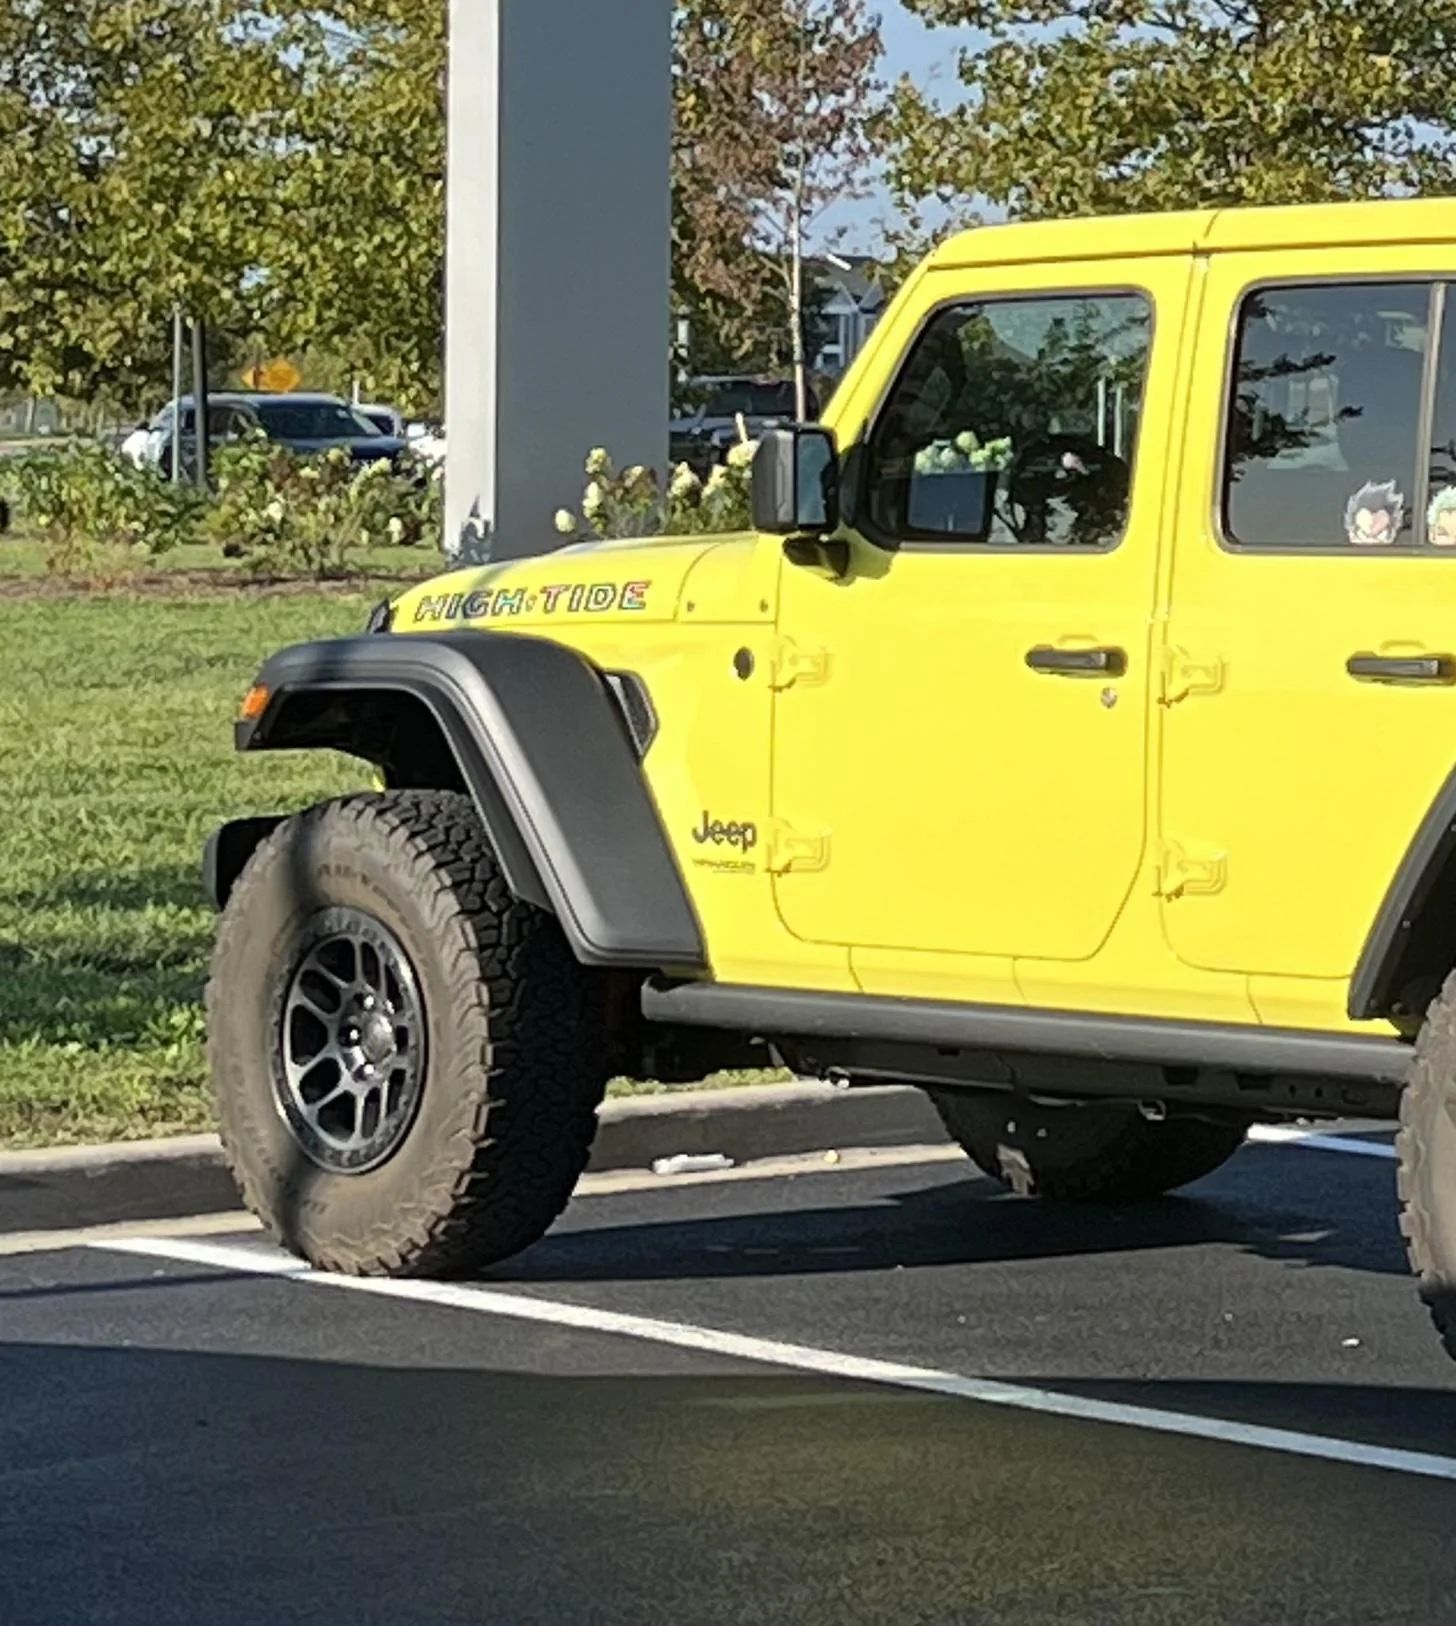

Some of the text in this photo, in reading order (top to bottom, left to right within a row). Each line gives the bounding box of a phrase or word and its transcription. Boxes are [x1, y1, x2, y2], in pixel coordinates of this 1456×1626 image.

[413, 579, 652, 623] HIGH TIDE
[691, 809, 757, 854] Jeep
